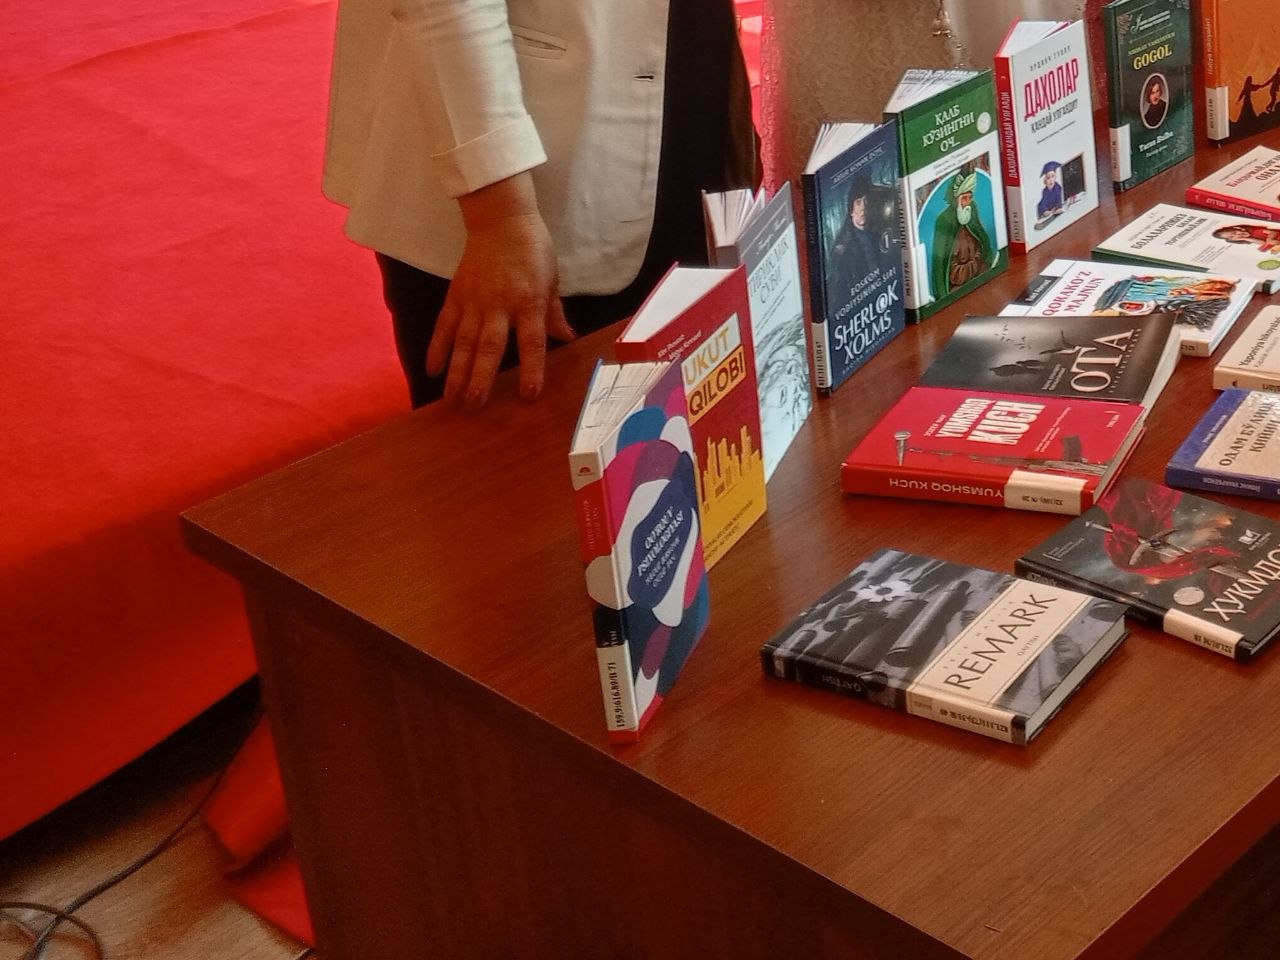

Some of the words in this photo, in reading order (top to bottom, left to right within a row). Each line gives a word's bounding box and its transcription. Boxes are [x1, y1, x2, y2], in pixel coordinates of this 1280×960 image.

[1133, 44, 1173, 70] GOGOL
[851, 267, 880, 297] BOSKOM
[1041, 270, 1092, 316] QORAKO'Z
[1063, 277, 1105, 313] MAJNUN
[684, 326, 729, 385] UKUT
[844, 309, 892, 365] XOLMS
[1238, 340, 1266, 368] Yaponiya
[1070, 328, 1135, 393] OTA
[689, 351, 744, 416] QILOBI
[935, 398, 997, 438] YUMSHOQ
[966, 401, 1047, 445] KUCH
[1219, 436, 1248, 468] ОДАМ
[889, 478, 928, 490] KUCH
[930, 482, 1005, 498] YUMSHOQ
[944, 592, 1058, 690] REMARK
